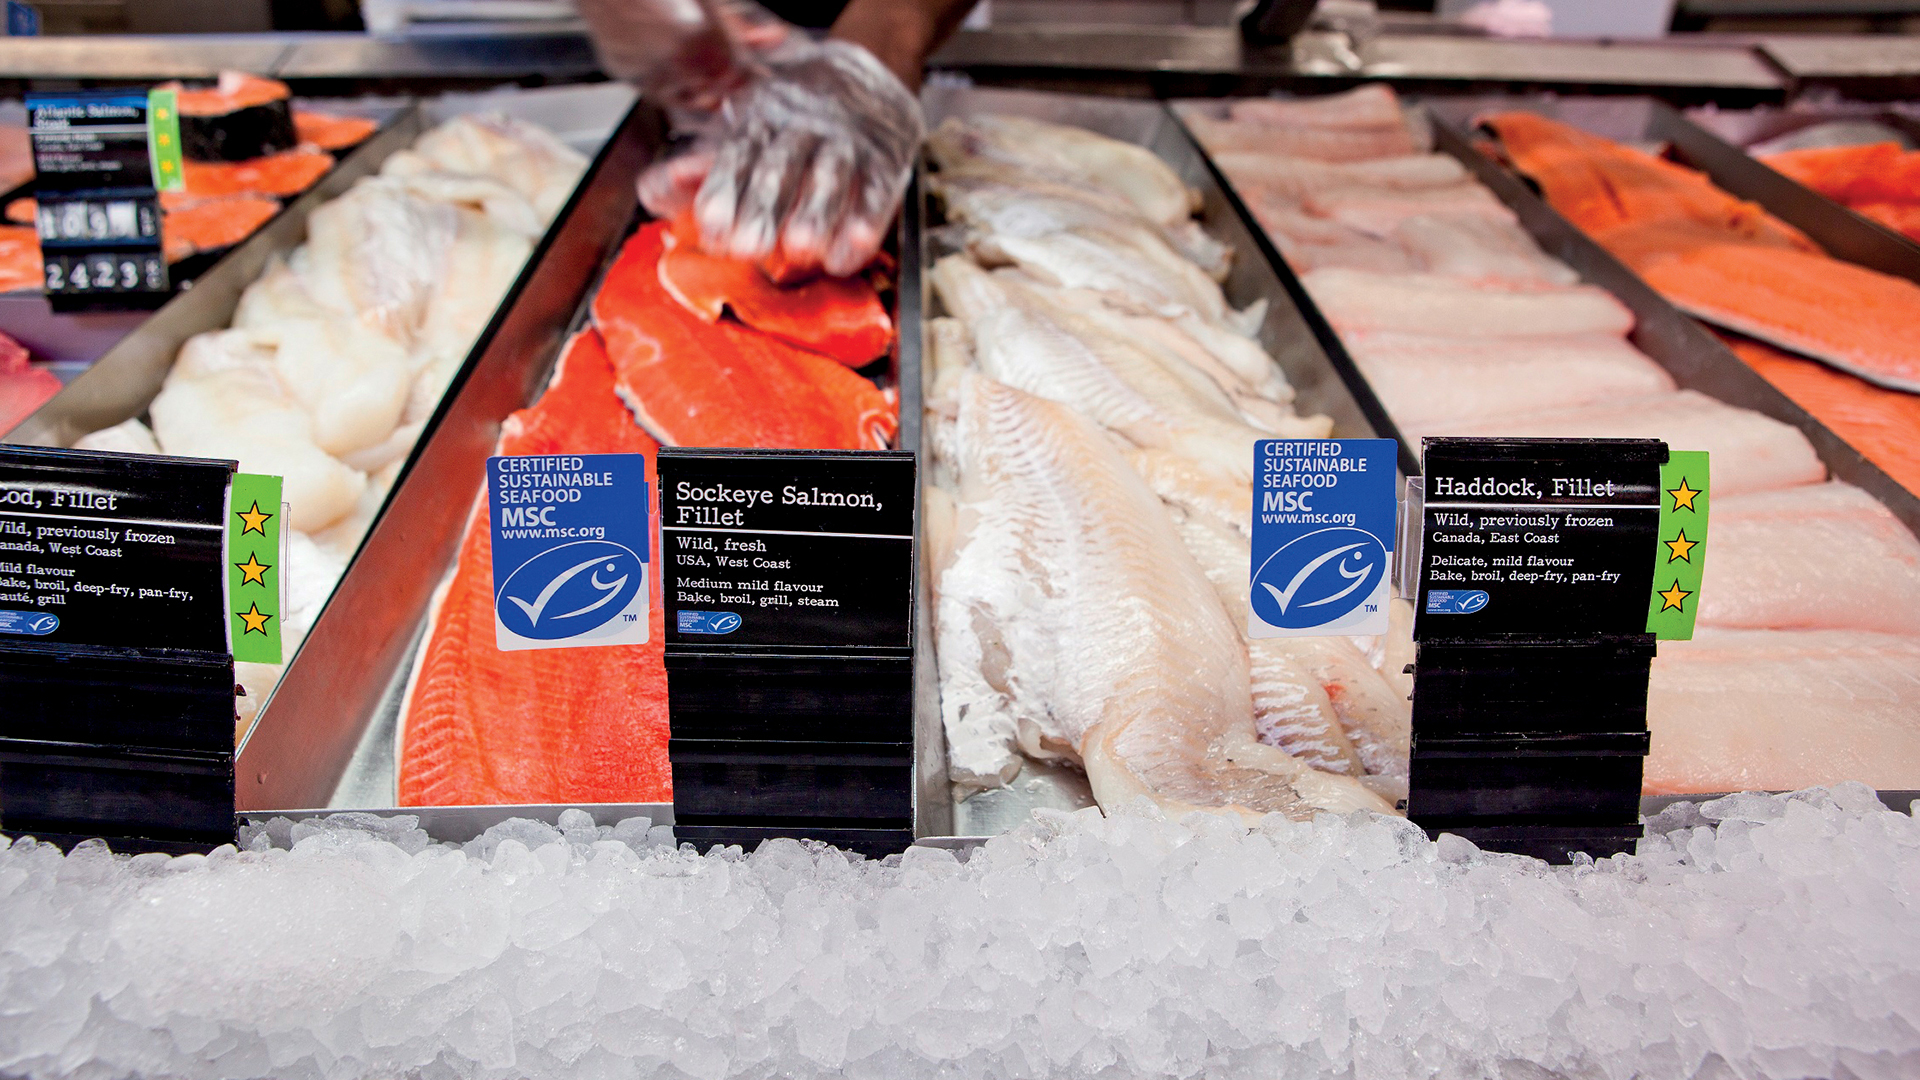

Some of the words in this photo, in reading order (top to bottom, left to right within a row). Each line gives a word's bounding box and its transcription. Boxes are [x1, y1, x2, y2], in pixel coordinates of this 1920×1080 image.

[1264, 442, 1342, 457] CERTIFIED
[497, 457, 584, 473] CERTIFIED
[1263, 458, 1367, 472] SUSTAINABLE
[498, 472, 613, 489] SUSTAINABLE
[1263, 473, 1338, 488] SEAFOOD
[1434, 477, 1543, 499] Haddock,
[1551, 478, 1615, 497] Fillet
[50, 489, 118, 511] Fillet
[499, 488, 582, 504] SEAFOOD
[676, 481, 774, 508] Sockeye
[782, 485, 883, 511] Salmon,
[1262, 491, 1313, 512] MSC
[501, 506, 557, 528] MSC
[676, 505, 744, 526] Fillet
[1261, 512, 1356, 526] www.msc.org
[1434, 512, 1474, 528] Wild,
[1479, 514, 1560, 530] previously
[1564, 514, 1614, 527] frozen
[36, 526, 119, 543] previously
[125, 529, 176, 545] frozen
[501, 526, 605, 540] www.msc.org
[1432, 532, 1485, 545] Canada,
[1489, 533, 1519, 543] East
[1523, 532, 1560, 544] Coast
[0, 541, 45, 554] anada,
[48, 542, 82, 555] West
[85, 545, 123, 558] Coast
[676, 536, 719, 553] Wild,
[724, 538, 767, 552] fresh
[676, 554, 711, 568] USA,
[716, 556, 749, 568] West
[753, 557, 791, 569] Coast
[1431, 555, 1488, 568] Delicate,
[1492, 555, 1523, 567] mild
[1526, 556, 1574, 567] flavour
[26, 564, 76, 577] flavour
[1430, 570, 1466, 582] Bake,
[1471, 570, 1505, 582] broil,
[1509, 570, 1568, 584] deep-fry,
[1571, 570, 1621, 584] pan-fry
[34, 579, 70, 593] broil,
[74, 581, 135, 598] deep-fry,
[138, 587, 194, 602] pan-fry,
[677, 577, 733, 590] Medium
[737, 580, 769, 591] mild
[773, 581, 824, 593] flavour
[0, 592, 34, 604] auté,
[37, 594, 66, 607] grill
[677, 591, 715, 604] Bake,
[720, 593, 756, 606] broil,
[760, 596, 793, 608] grill,
[797, 597, 839, 607] steam
[1364, 604, 1378, 613] TM
[622, 614, 638, 622] TM
